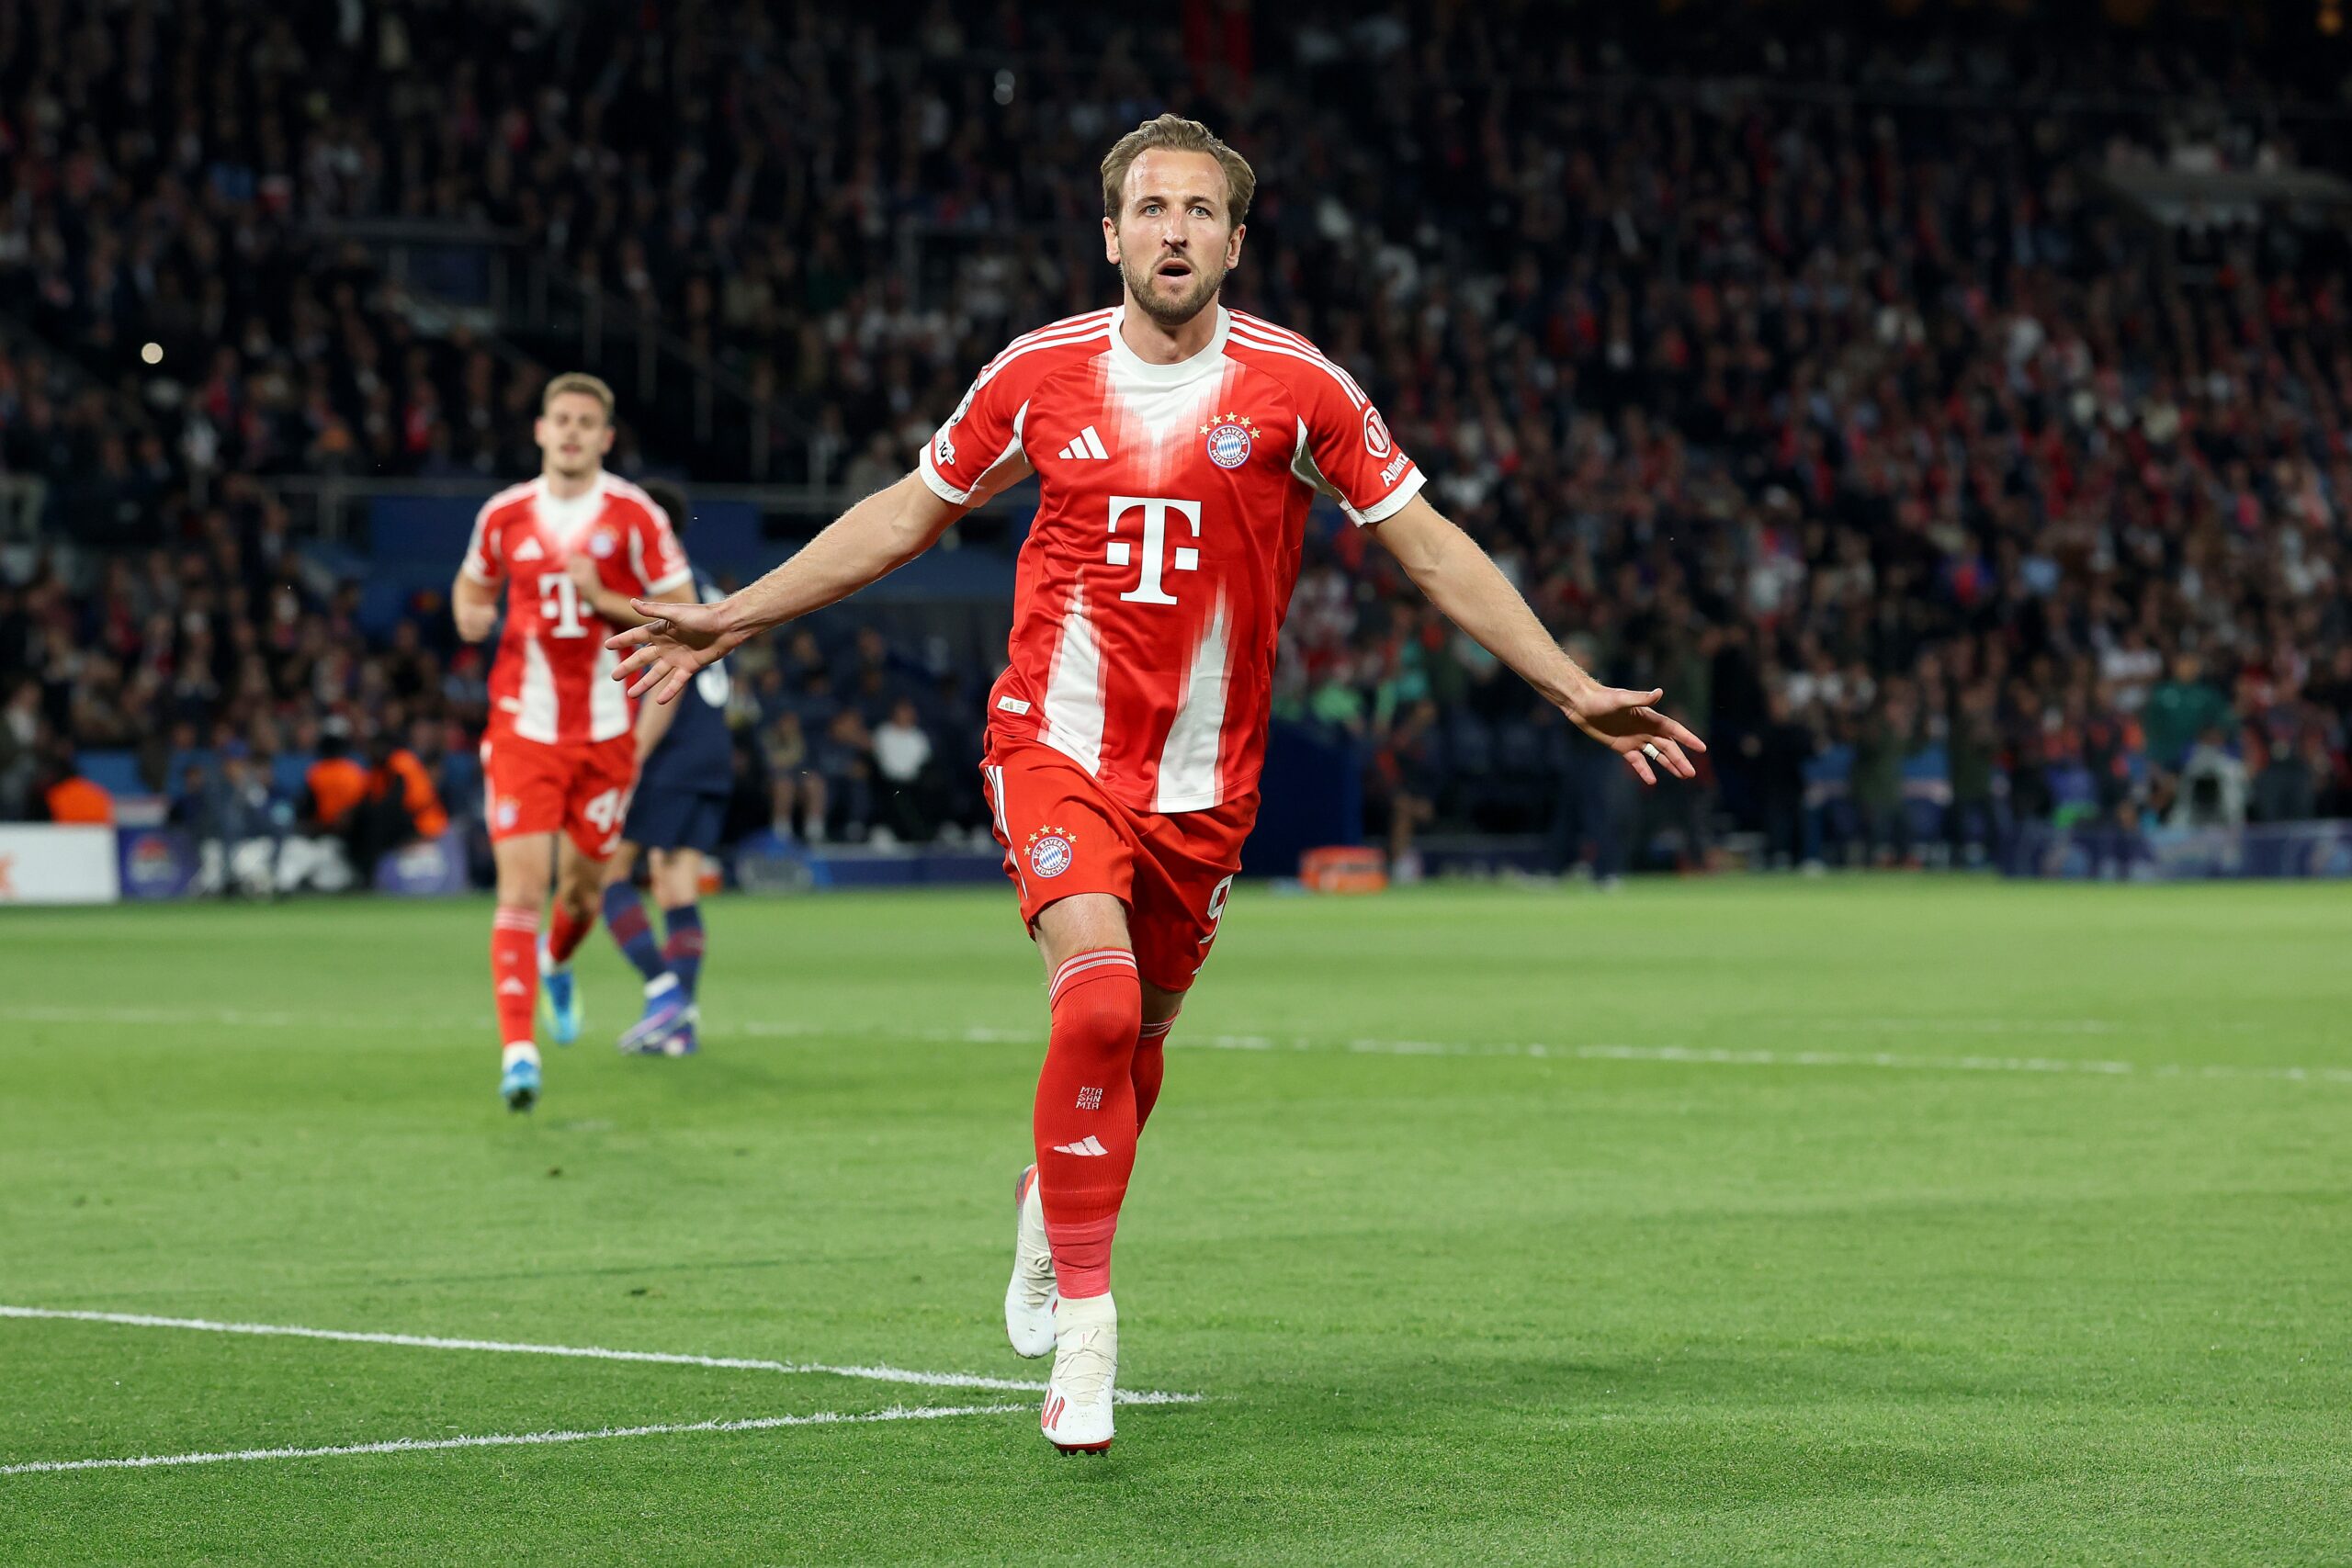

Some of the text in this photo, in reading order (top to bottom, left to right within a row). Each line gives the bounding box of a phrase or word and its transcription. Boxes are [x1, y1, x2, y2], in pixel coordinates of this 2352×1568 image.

[1212, 427, 1248, 446] FC BAYERN
[1106, 495, 1202, 605] T
[1034, 840, 1067, 859] FC BAYERN
[1198, 873, 1234, 944] 9
[1078, 1094, 1101, 1102] SAN
[1080, 1086, 1103, 1095] MIA
[1075, 1101, 1099, 1110] MIA
